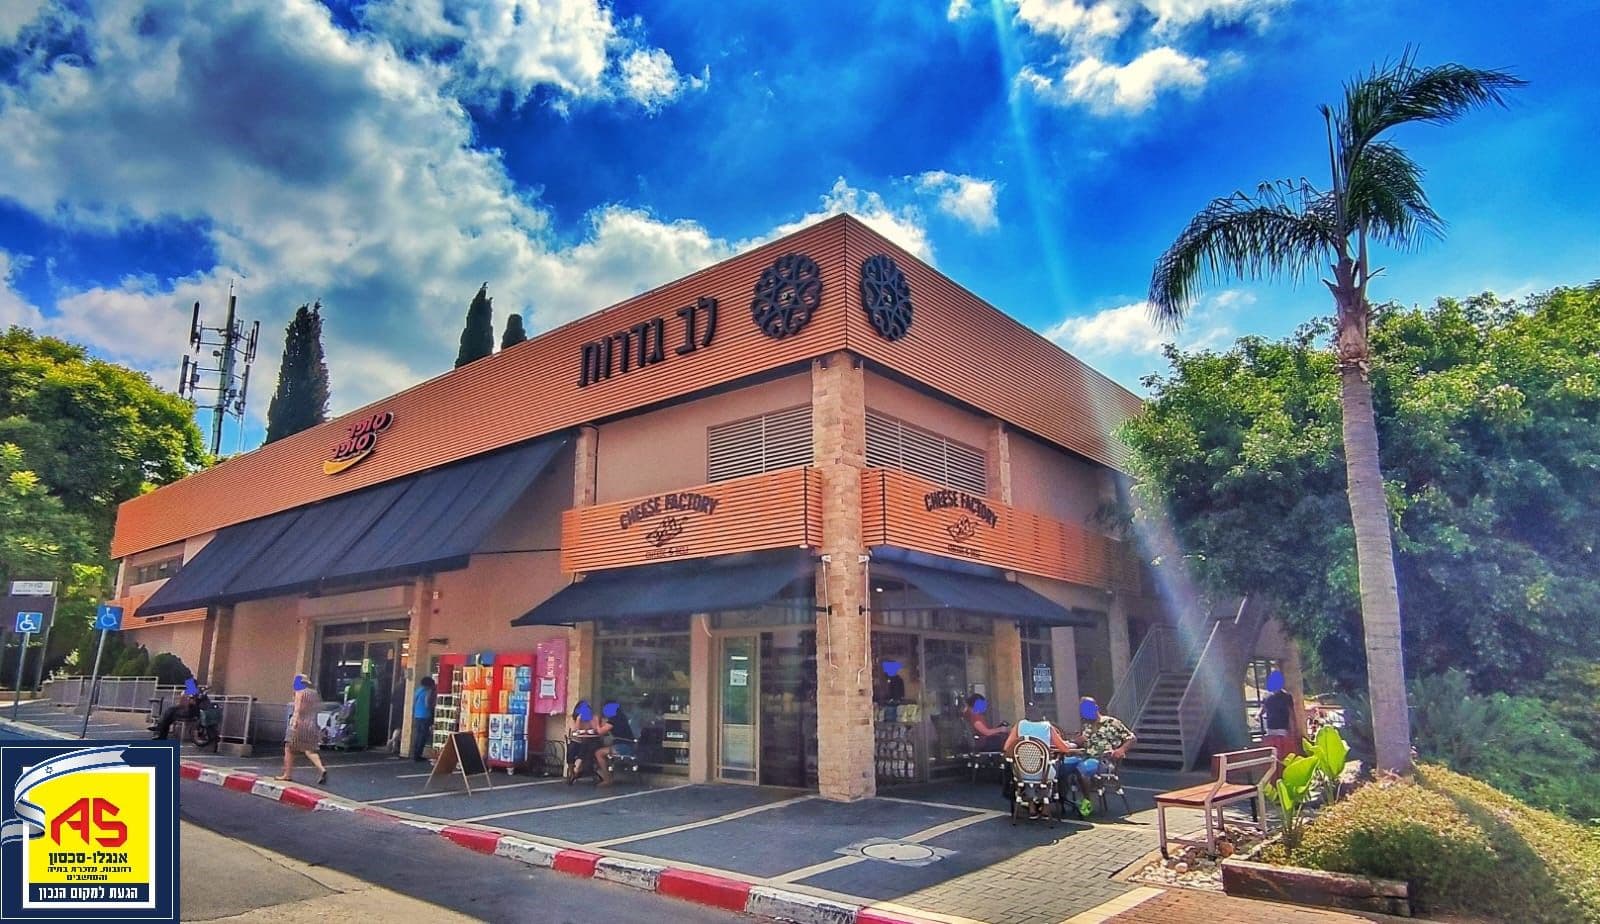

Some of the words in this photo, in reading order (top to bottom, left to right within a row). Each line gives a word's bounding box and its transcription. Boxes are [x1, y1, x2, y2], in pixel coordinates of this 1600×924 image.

[675, 296, 718, 355] לב
[576, 317, 665, 388] גדרות
[620, 496, 661, 530] CHEESE
[664, 492, 719, 515] FACTORY
[924, 489, 959, 512] CHEESE
[960, 492, 998, 529] FACTORY
